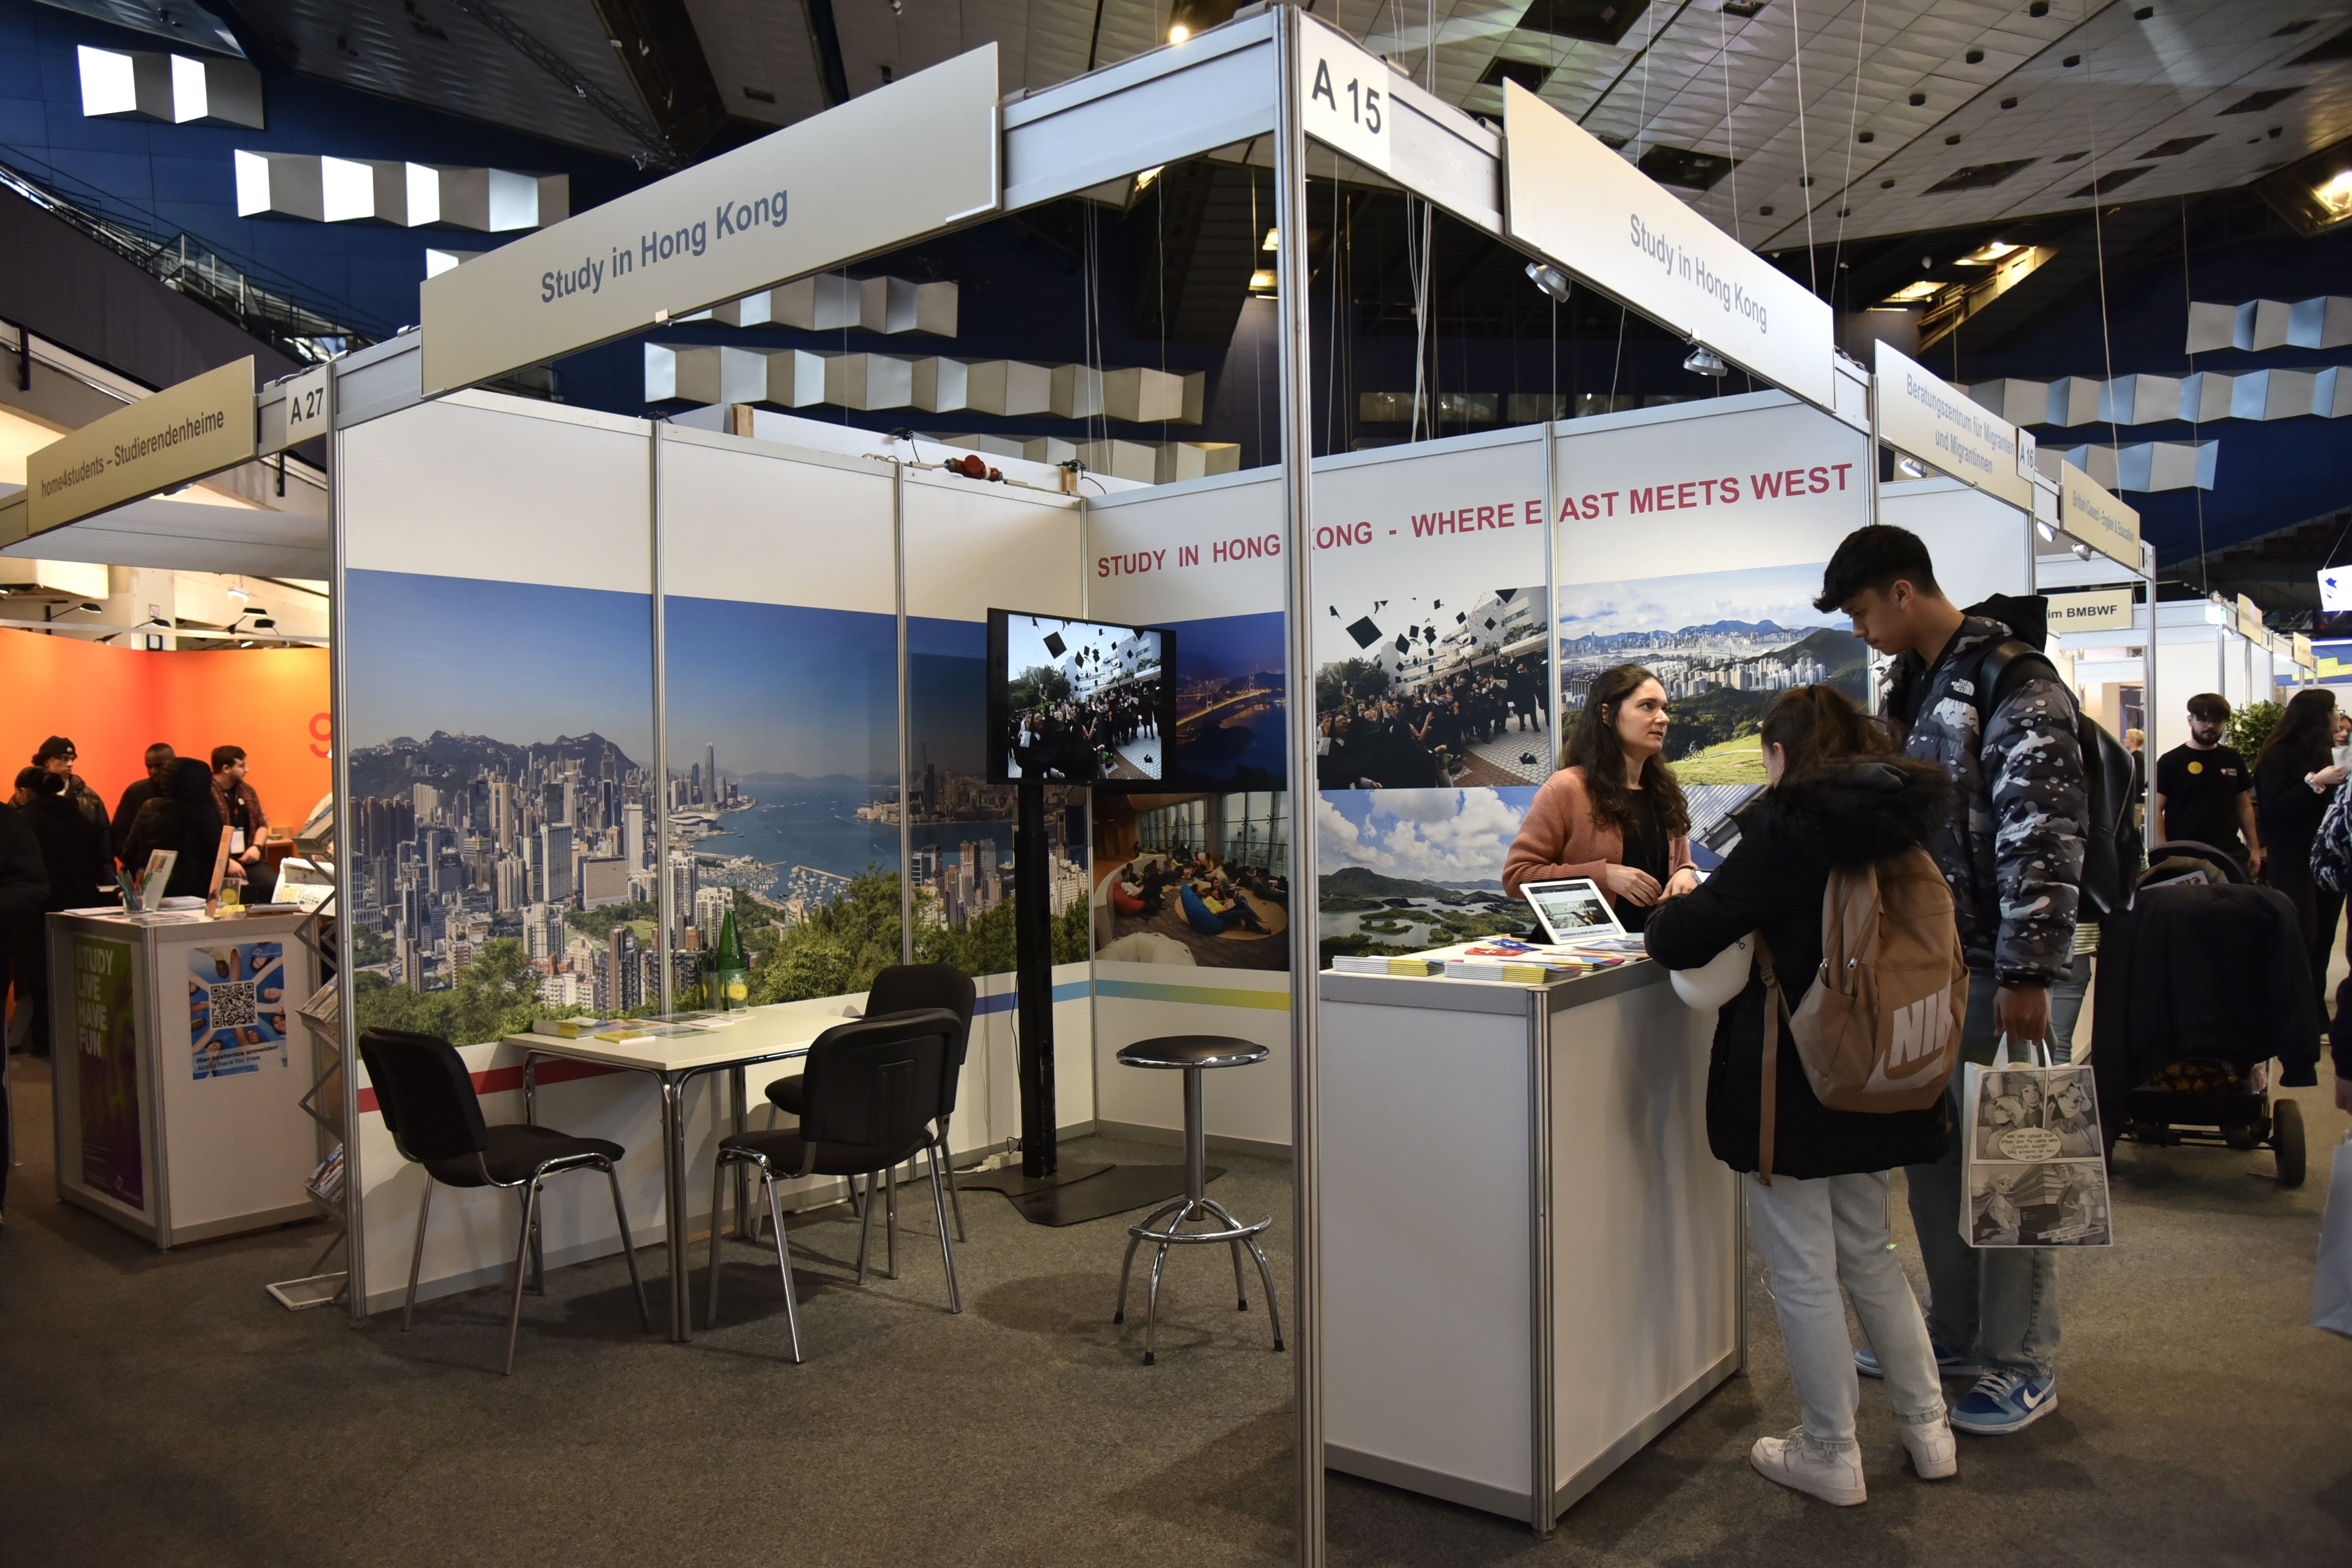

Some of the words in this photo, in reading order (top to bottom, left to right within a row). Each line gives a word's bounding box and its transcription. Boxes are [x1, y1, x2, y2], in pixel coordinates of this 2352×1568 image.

[1311, 58, 1337, 112] A
[1347, 78, 1381, 134] 15
[541, 257, 604, 303] Study
[612, 247, 632, 278] in
[641, 221, 707, 267] Hong
[716, 189, 788, 240] Kong
[1630, 213, 1674, 276] Study
[1678, 245, 1691, 281] in
[1696, 256, 1731, 312] Hong
[1734, 282, 1767, 334] Kong
[290, 397, 303, 425] A
[305, 387, 324, 420] 27
[1906, 373, 1972, 433] Beratungszentrum
[1973, 415, 1982, 438] für
[1984, 421, 2015, 457] Migranten
[41, 455, 104, 499] home4students
[114, 409, 224, 467] Studierendenheime
[1935, 429, 1949, 452] und
[1950, 437, 1993, 475] Migrantinnen
[2020, 443, 2026, 463] A
[2027, 446, 2034, 468] 16
[1098, 549, 1166, 578] STUDY
[1179, 545, 1199, 567] IN
[1213, 534, 1281, 563] HONG
[1313, 521, 1373, 550] ONG
[1411, 500, 1515, 538] WHERE
[1630, 477, 1740, 514] MEETS
[1750, 463, 1853, 501] WEST
[2066, 604, 2118, 618] BMBWF
[76, 945, 114, 976] STUDY
[77, 971, 101, 1001] LIVE
[78, 1000, 107, 1032] HAVE
[78, 1027, 102, 1058] FUN
[246, 1045, 278, 1056] anmelden
